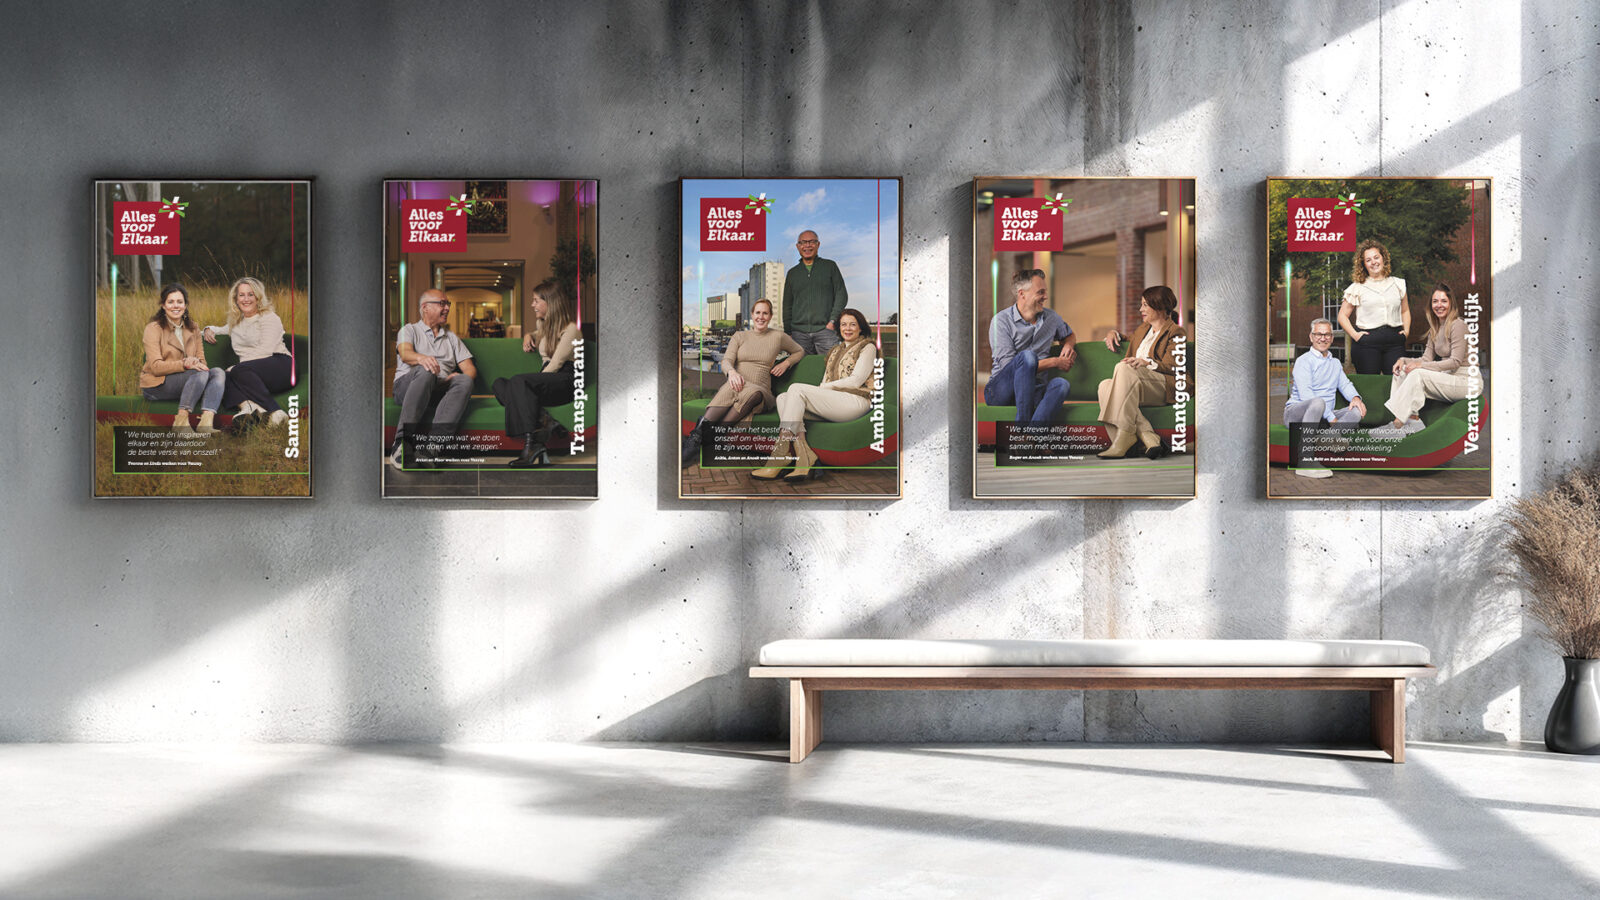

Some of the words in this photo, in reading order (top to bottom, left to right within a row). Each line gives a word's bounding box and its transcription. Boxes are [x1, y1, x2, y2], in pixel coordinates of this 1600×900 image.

[120, 211, 156, 222] Alles
[408, 209, 444, 220] Alles
[707, 207, 742, 218] Alles
[1002, 207, 1038, 218] Alles
[1295, 208, 1332, 219] Alles
[121, 224, 154, 232] voor
[409, 222, 442, 230] voor
[708, 220, 741, 228] voor
[1002, 220, 1037, 228] voor
[1295, 220, 1330, 229] voor
[120, 233, 168, 244] Elkaar.
[408, 231, 455, 242] Elkaar.
[707, 230, 754, 240] Elkaar.
[1001, 230, 1051, 240] Elkaar.
[1294, 230, 1344, 241] Elkaar.
[1464, 293, 1482, 454] Verantwoordelijk
[570, 339, 588, 455] Transparant
[1172, 336, 1190, 452] Klantgericht
[870, 358, 884, 454] Ambitieus
[285, 394, 299, 458] Samen
[1050, 426, 1067, 434] altijd
[141, 431, 164, 439] helpen
[768, 435, 780, 443] dag
[1062, 435, 1097, 443] oplossing
[160, 440, 173, 448] zijn
[1302, 445, 1346, 453] persoonlijke
